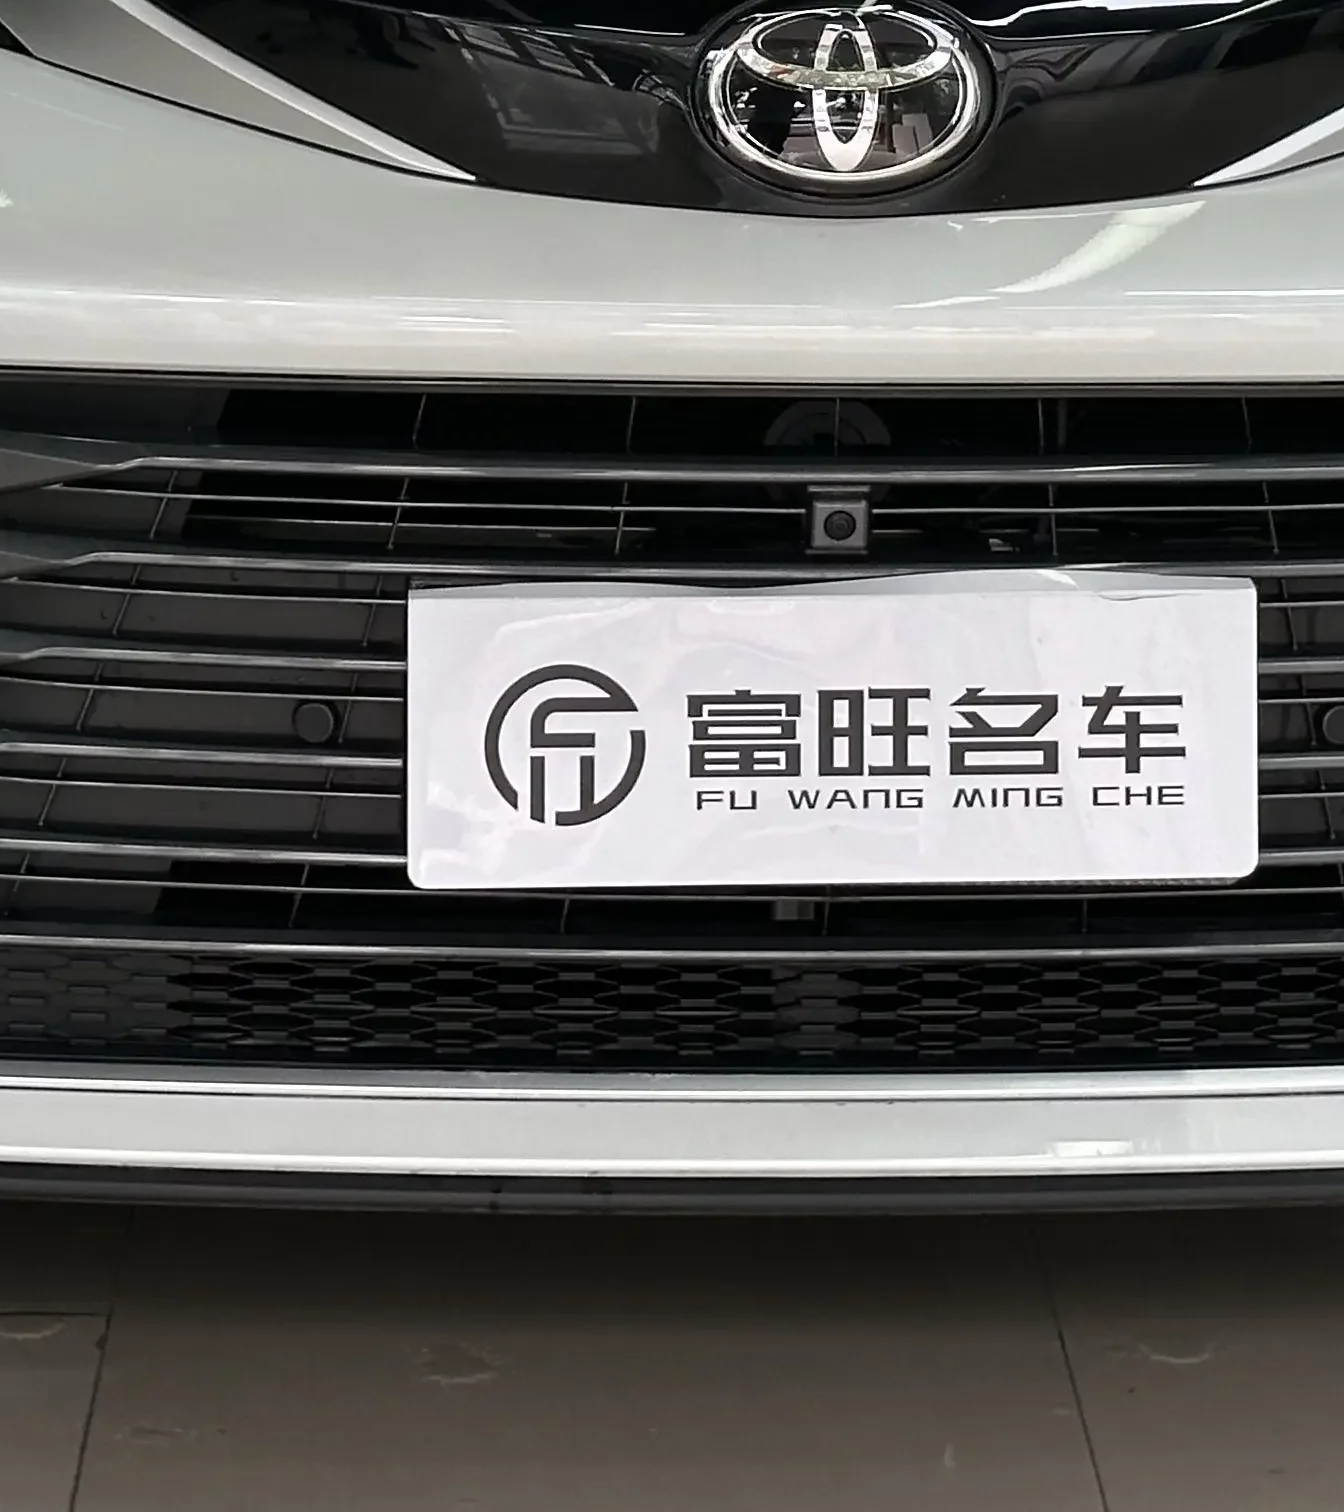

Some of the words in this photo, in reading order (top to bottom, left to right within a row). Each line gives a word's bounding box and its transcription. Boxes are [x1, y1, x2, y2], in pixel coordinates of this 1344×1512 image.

[687, 684, 1187, 778] 富旺名车
[696, 790, 757, 811] FU
[787, 788, 924, 810] WANG
[952, 787, 1064, 809] MING
[1092, 785, 1186, 807] CHE
